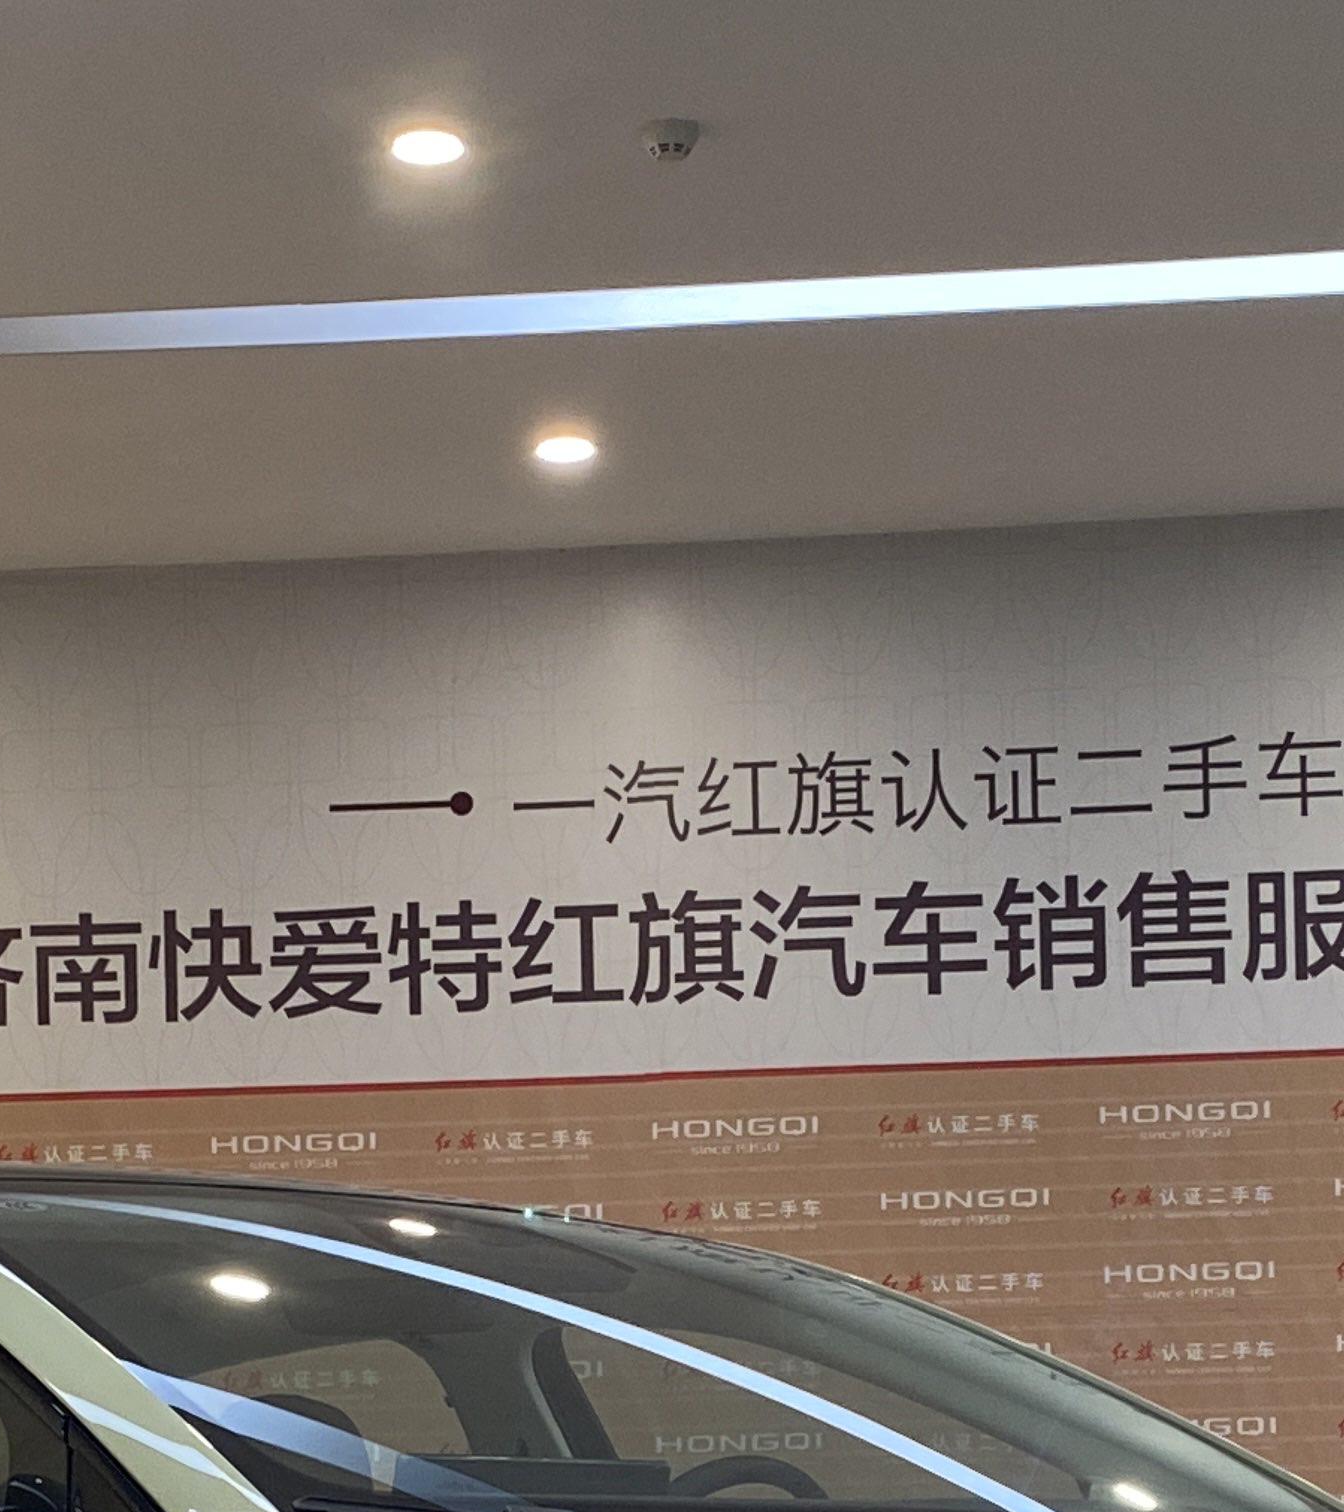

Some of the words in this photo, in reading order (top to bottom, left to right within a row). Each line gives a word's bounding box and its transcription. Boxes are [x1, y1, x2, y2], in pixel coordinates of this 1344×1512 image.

[513, 730, 1344, 843] 一汽红旗认证二手车
[1100, 1100, 1270, 1123] HONGQI
[652, 1116, 818, 1139] HONGQI
[212, 1132, 376, 1153] HONGQI
[881, 1188, 1049, 1210] HONGQI
[1104, 1261, 1275, 1283] HONGQI
